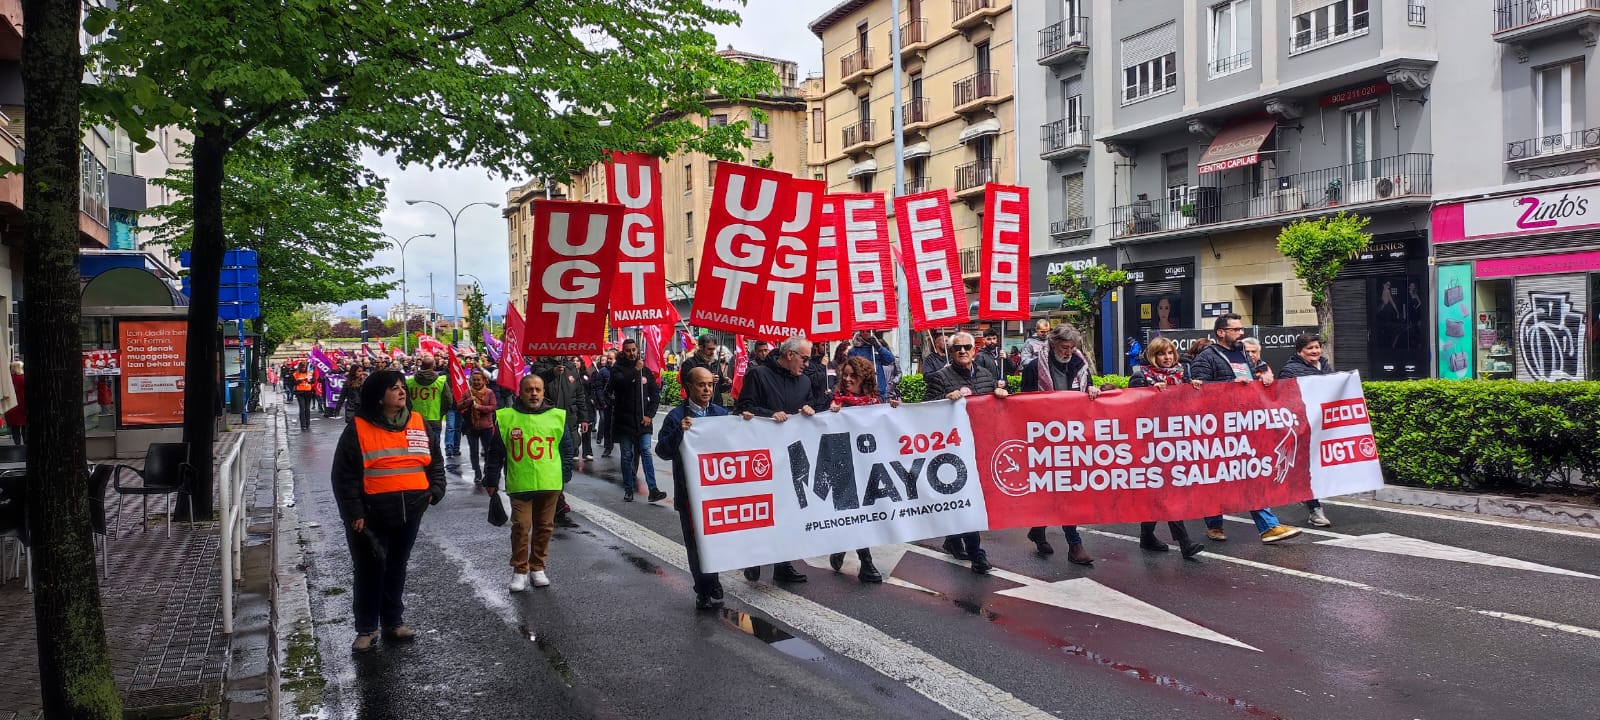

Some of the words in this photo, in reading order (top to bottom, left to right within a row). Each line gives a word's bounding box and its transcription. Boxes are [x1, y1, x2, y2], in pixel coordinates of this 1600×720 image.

[1199, 162, 1227, 174] CENTRO
[1227, 155, 1257, 168] CAPILAR
[1516, 193, 1589, 230] Zinto's
[614, 163, 656, 306] UGT
[711, 173, 778, 311] UGT
[541, 211, 609, 339] UGT
[614, 308, 664, 321] NAVARRA
[695, 310, 756, 330] NAVARRA
[759, 324, 807, 339] AVARRA
[127, 353, 180, 361] mugagabea
[527, 341, 597, 351] NAVARRA
[409, 386, 438, 401] UGT
[1027, 419, 1087, 444] POR
[1095, 418, 1129, 441] EL
[1136, 414, 1217, 440] PLENO
[1223, 405, 1300, 435] EMPLEO:
[1324, 403, 1366, 424] CCOO
[510, 436, 555, 462] UGT
[898, 428, 962, 455] 2024
[1027, 441, 1134, 470] MENOS
[1140, 434, 1258, 465] JORNADA,
[1321, 440, 1356, 463] UGT
[702, 455, 750, 482] UGT
[1027, 464, 1165, 494] MEJORES
[1171, 456, 1273, 488] SALARIOS
[707, 501, 769, 527] CCOO
[804, 511, 888, 533] #PLENOEMPLEO
[899, 498, 972, 519] #1MAYO2024
